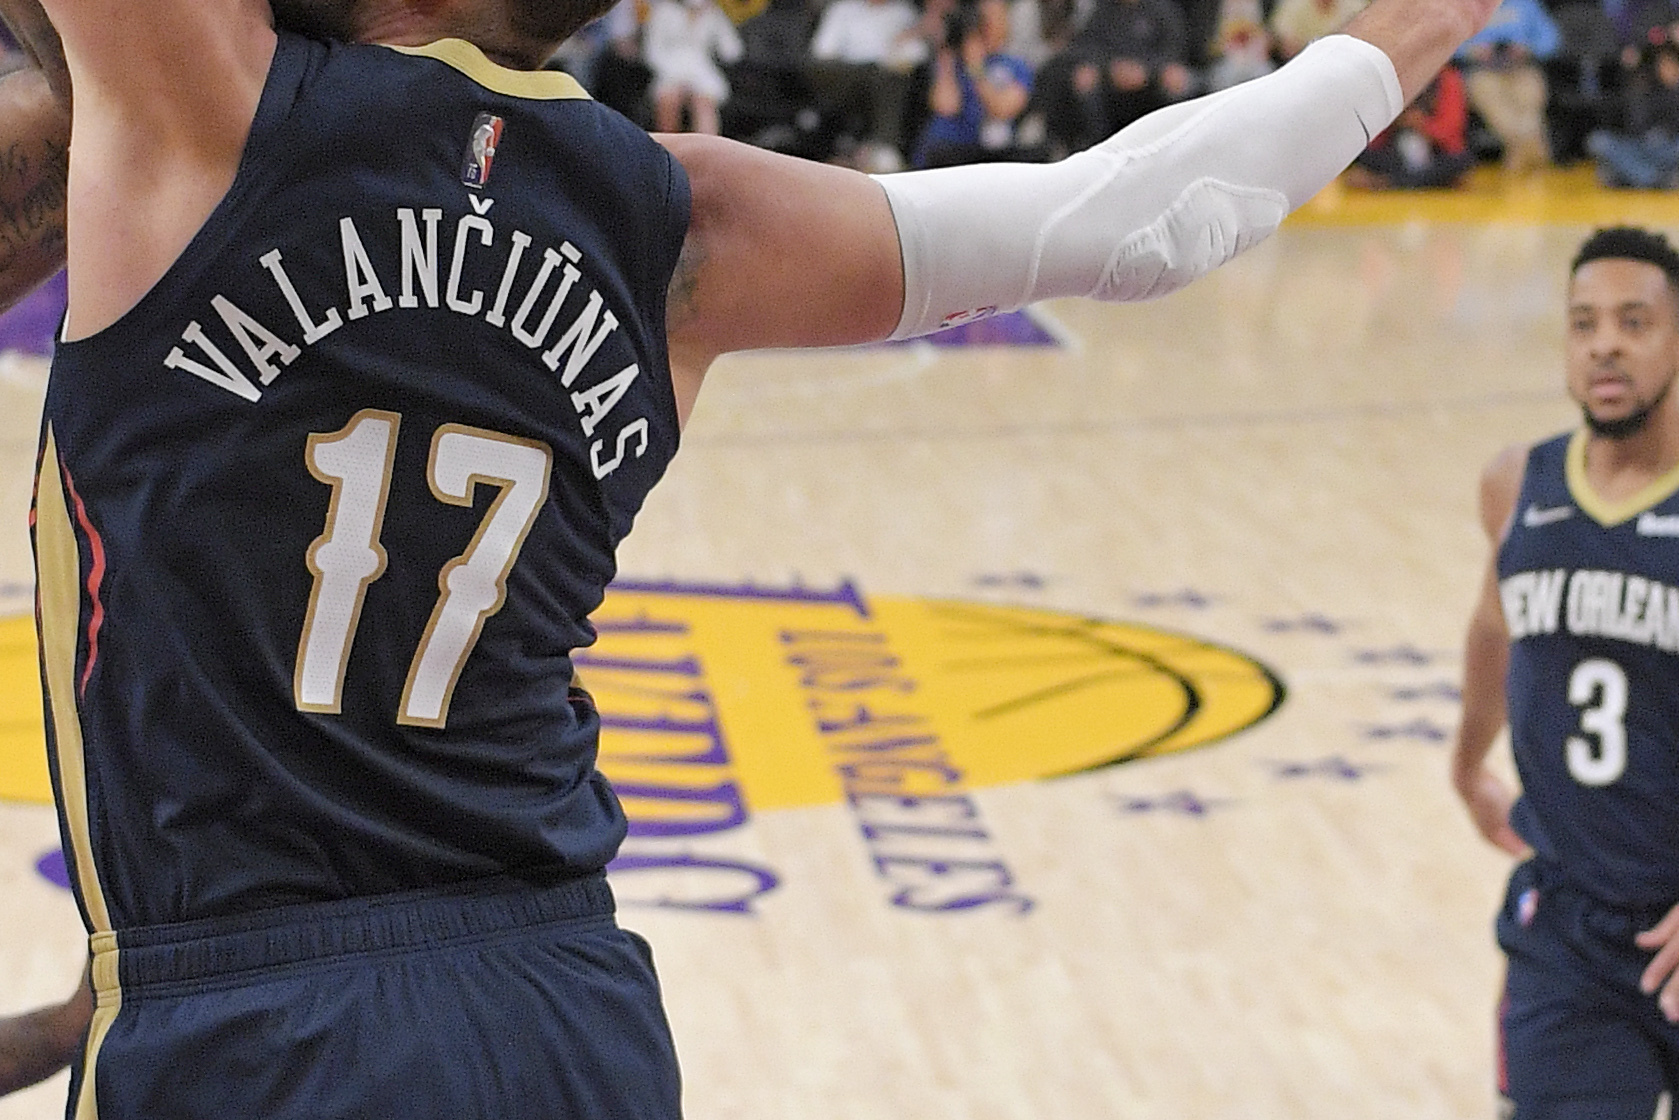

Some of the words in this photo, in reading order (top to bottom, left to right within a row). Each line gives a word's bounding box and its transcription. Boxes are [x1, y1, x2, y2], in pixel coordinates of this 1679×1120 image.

[163, 193, 650, 481] VALANČIŪNAS
[294, 408, 554, 729] 17
[1565, 656, 1629, 788] 3
